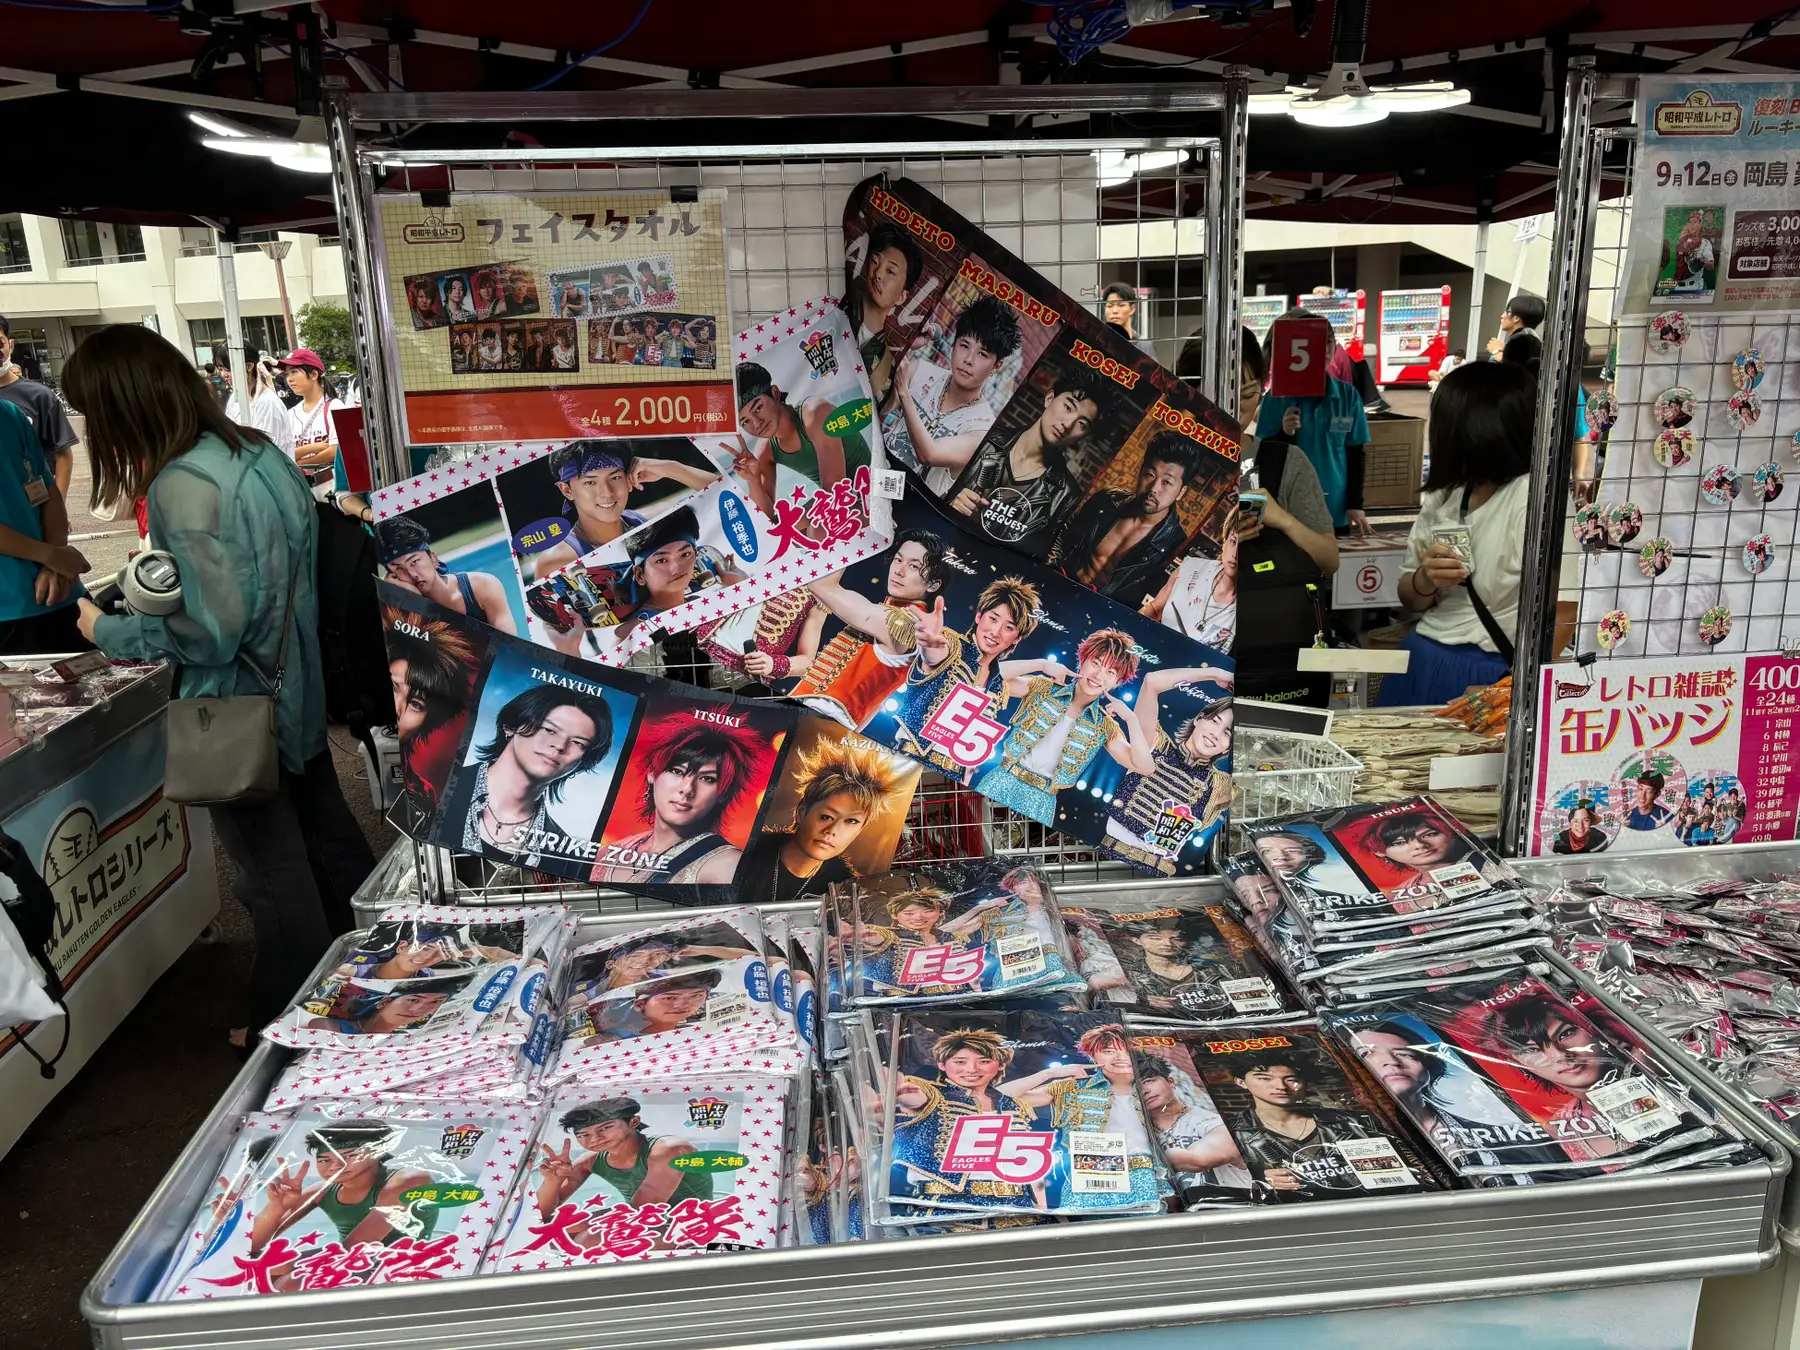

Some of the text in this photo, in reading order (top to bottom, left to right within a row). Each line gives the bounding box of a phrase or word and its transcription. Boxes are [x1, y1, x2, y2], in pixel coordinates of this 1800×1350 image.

[1664, 111, 1733, 123] 昭和平成レトロ
[476, 209, 701, 245] フェイスタオル
[870, 186, 955, 252] HIDETO
[958, 259, 1060, 328] MASARU
[1289, 338, 1310, 371] 5
[1069, 339, 1140, 391] KOSEI
[826, 414, 850, 433] 中島
[1152, 400, 1241, 462] TOSHIKI
[990, 496, 1017, 516] THE
[723, 498, 755, 556] 伊藤 裕季也
[984, 507, 1030, 534] REQUEST
[520, 522, 564, 549] 宗山 塁
[940, 550, 979, 576] Takero
[393, 618, 431, 644] SORA
[529, 667, 603, 698] TAKAYUKI
[1173, 680, 1217, 705] Kohtaro
[1600, 671, 1727, 702] レトロ雑誌
[1265, 687, 1309, 702] balance
[693, 709, 741, 729] ITSUKI
[935, 684, 1002, 763] E5
[1560, 698, 1735, 755] 缶バッジ
[927, 729, 945, 743] FIVE
[929, 723, 956, 742] EAGLES
[1763, 731, 1770, 740] 6
[1763, 743, 1769, 752] 8
[1758, 755, 1769, 763] 21
[1757, 767, 1768, 775] 31
[1756, 778, 1768, 787] 32
[1755, 790, 1767, 798] 39
[1371, 802, 1418, 819] ITSUKI
[1754, 801, 1766, 810] 46
[1753, 812, 1765, 820] 48
[1752, 824, 1762, 832] 51
[510, 825, 672, 873] STRIKE ZONE
[62, 932, 90, 965] RAKUTEN
[89, 906, 113, 936] GOLDEN
[113, 886, 137, 913] EAGLES
[907, 945, 983, 983] E5
[494, 970, 514, 984] 伊藤
[1175, 990, 1202, 1000] THE
[1480, 978, 1535, 1010] ITSUKI
[1206, 1035, 1292, 1055] KOSEI
[1433, 1120, 1546, 1152] STRIKE
[952, 1117, 1048, 1180] E5
[674, 1156, 744, 1168] 中島 大輔
[951, 1156, 992, 1164] EAGLES
[1302, 1157, 1340, 1172] THE
[1306, 1165, 1354, 1181] REQUE
[405, 1189, 478, 1202] 中島 大輔
